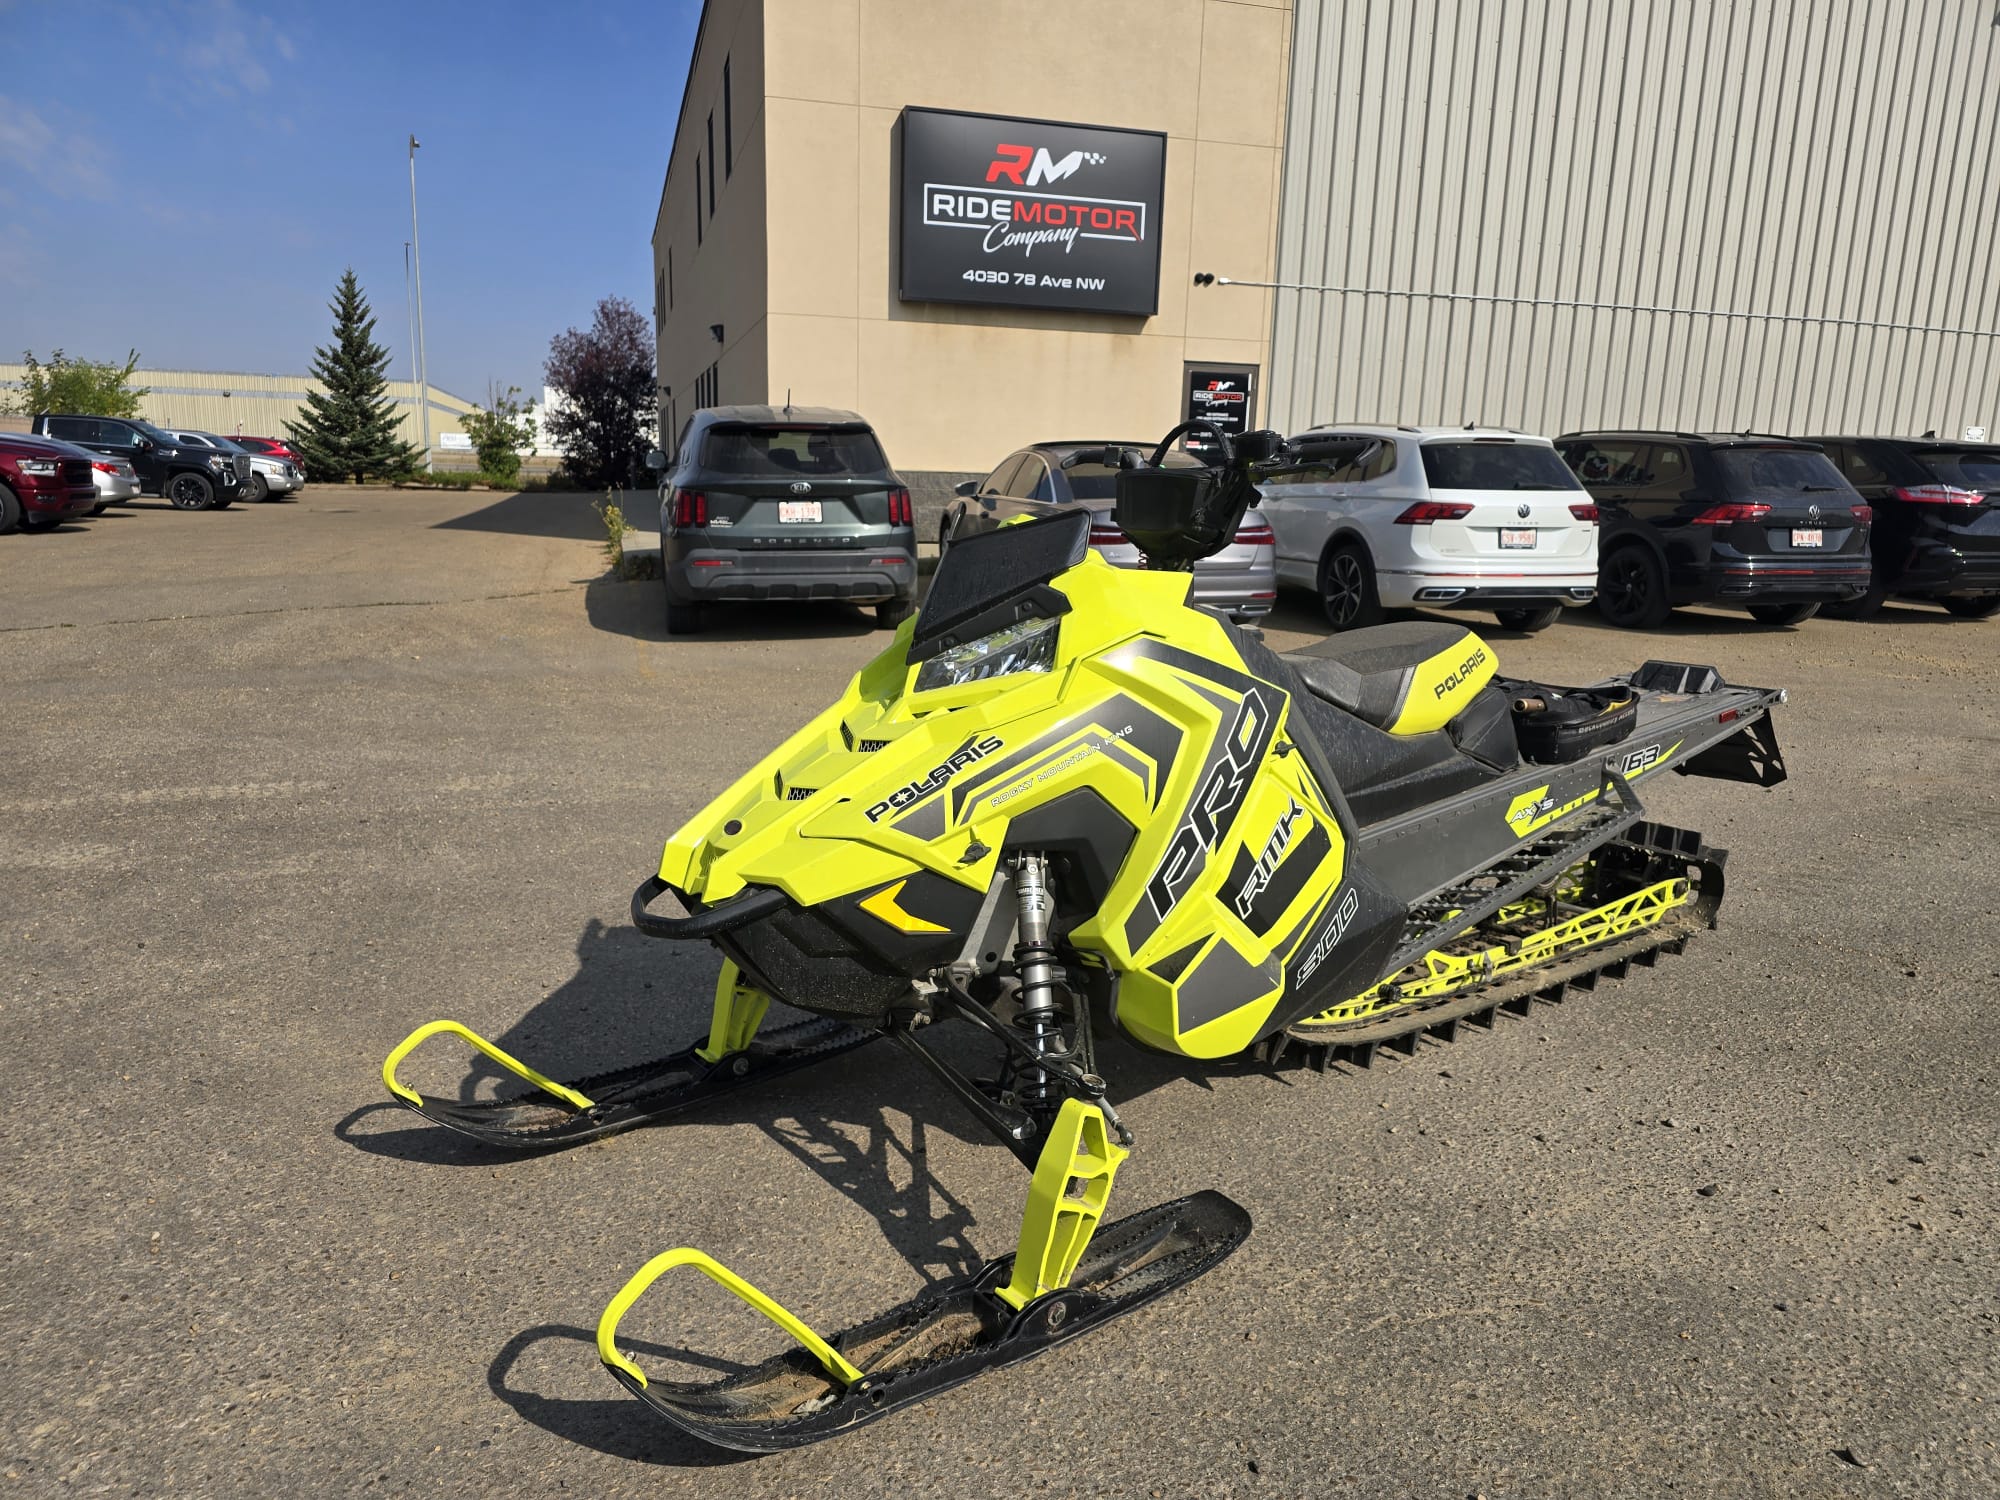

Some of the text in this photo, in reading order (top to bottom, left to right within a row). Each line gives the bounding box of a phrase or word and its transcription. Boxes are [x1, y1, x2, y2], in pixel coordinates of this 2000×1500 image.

[986, 143, 1083, 186] RM
[983, 221, 1080, 257] Company
[963, 269, 1106, 290] 4030 78 Ave NW
[1434, 648, 1486, 700] POLARIS
[864, 734, 1005, 823] POLARIS
[990, 725, 1133, 807] ROCKY MOUNTAIN KING
[1620, 744, 1660, 774] 163
[1145, 687, 1269, 924] PRO
[1510, 797, 1554, 827] AXYS
[1235, 794, 1305, 920] RMK
[1296, 888, 1359, 990] 800
